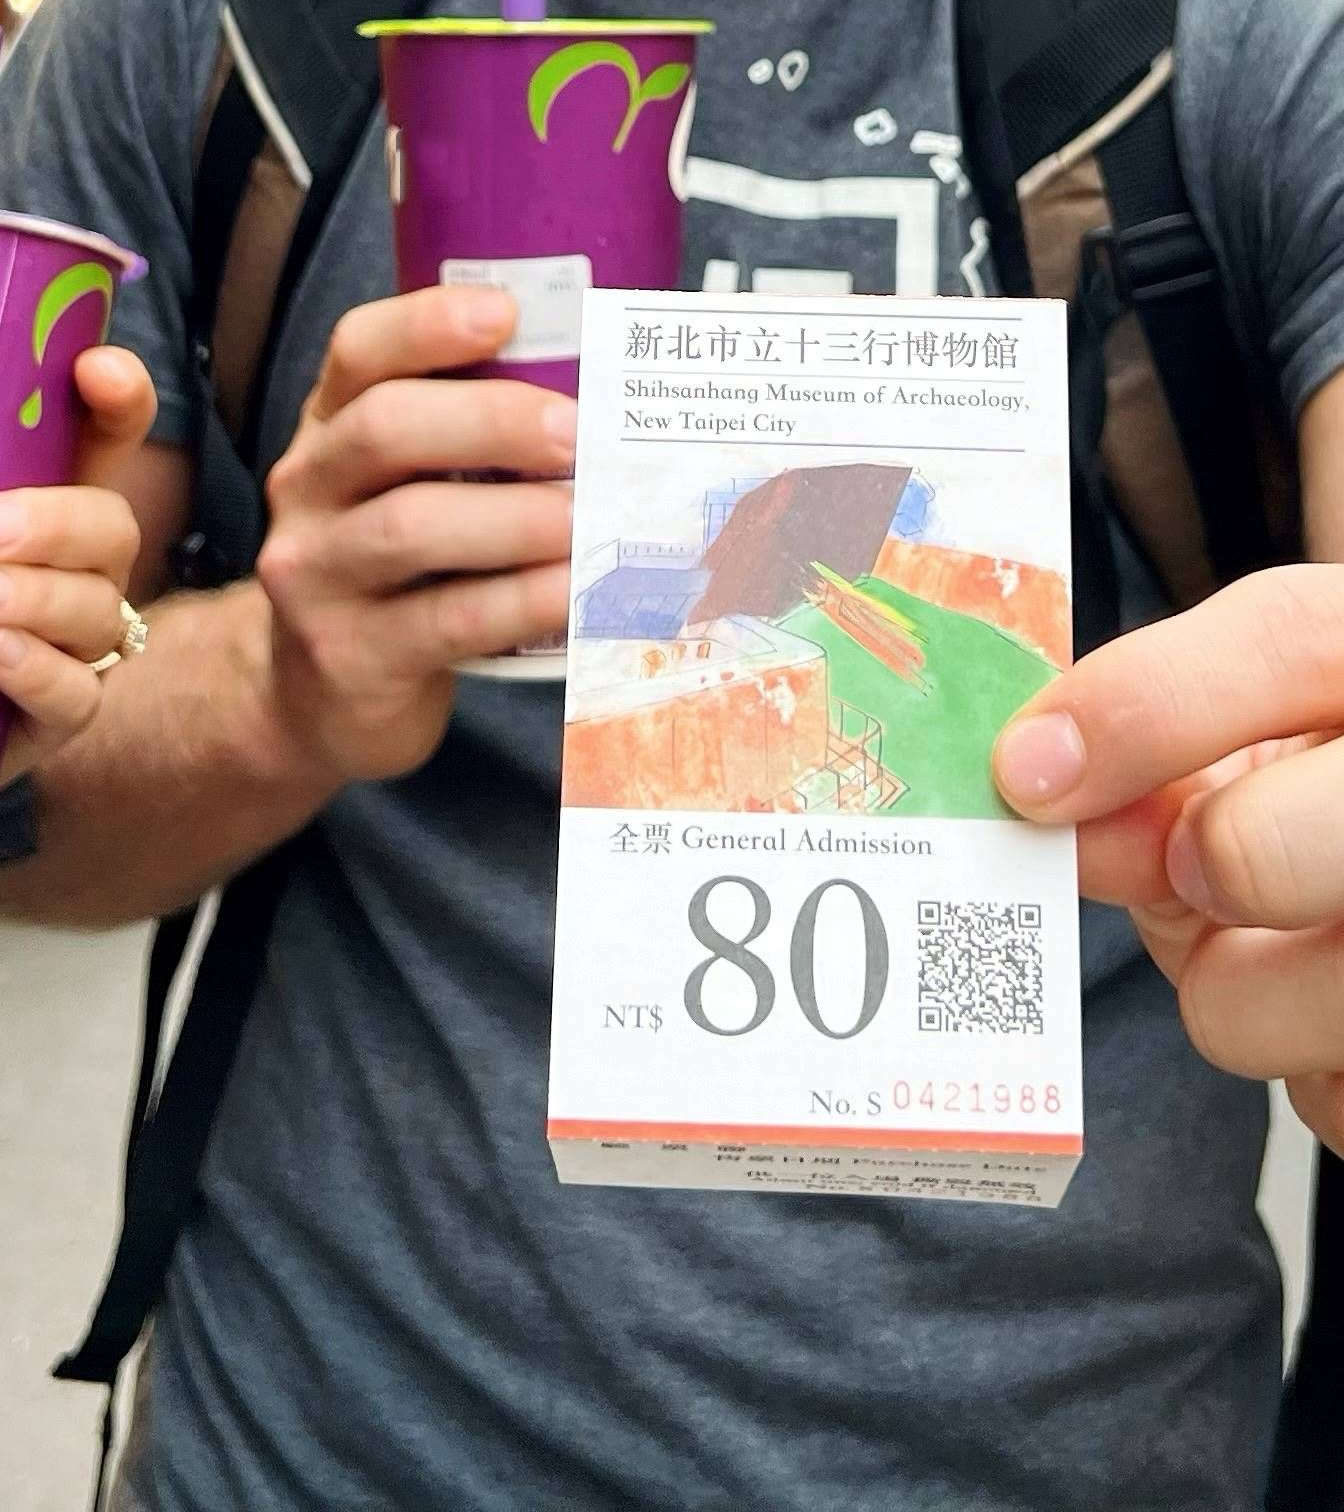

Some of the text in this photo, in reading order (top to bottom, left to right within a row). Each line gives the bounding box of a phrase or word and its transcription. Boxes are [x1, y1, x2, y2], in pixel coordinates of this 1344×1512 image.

[624, 319, 1020, 370] 新北市立十三行博物館
[624, 379, 1031, 414] Shihsanhang Museum of Archaeology,
[623, 410, 798, 438] New Taipei City
[608, 822, 933, 857] 全票 General Admission
[602, 874, 890, 1041] NT$ 80
[809, 1079, 1062, 1117] No. S 0421988
